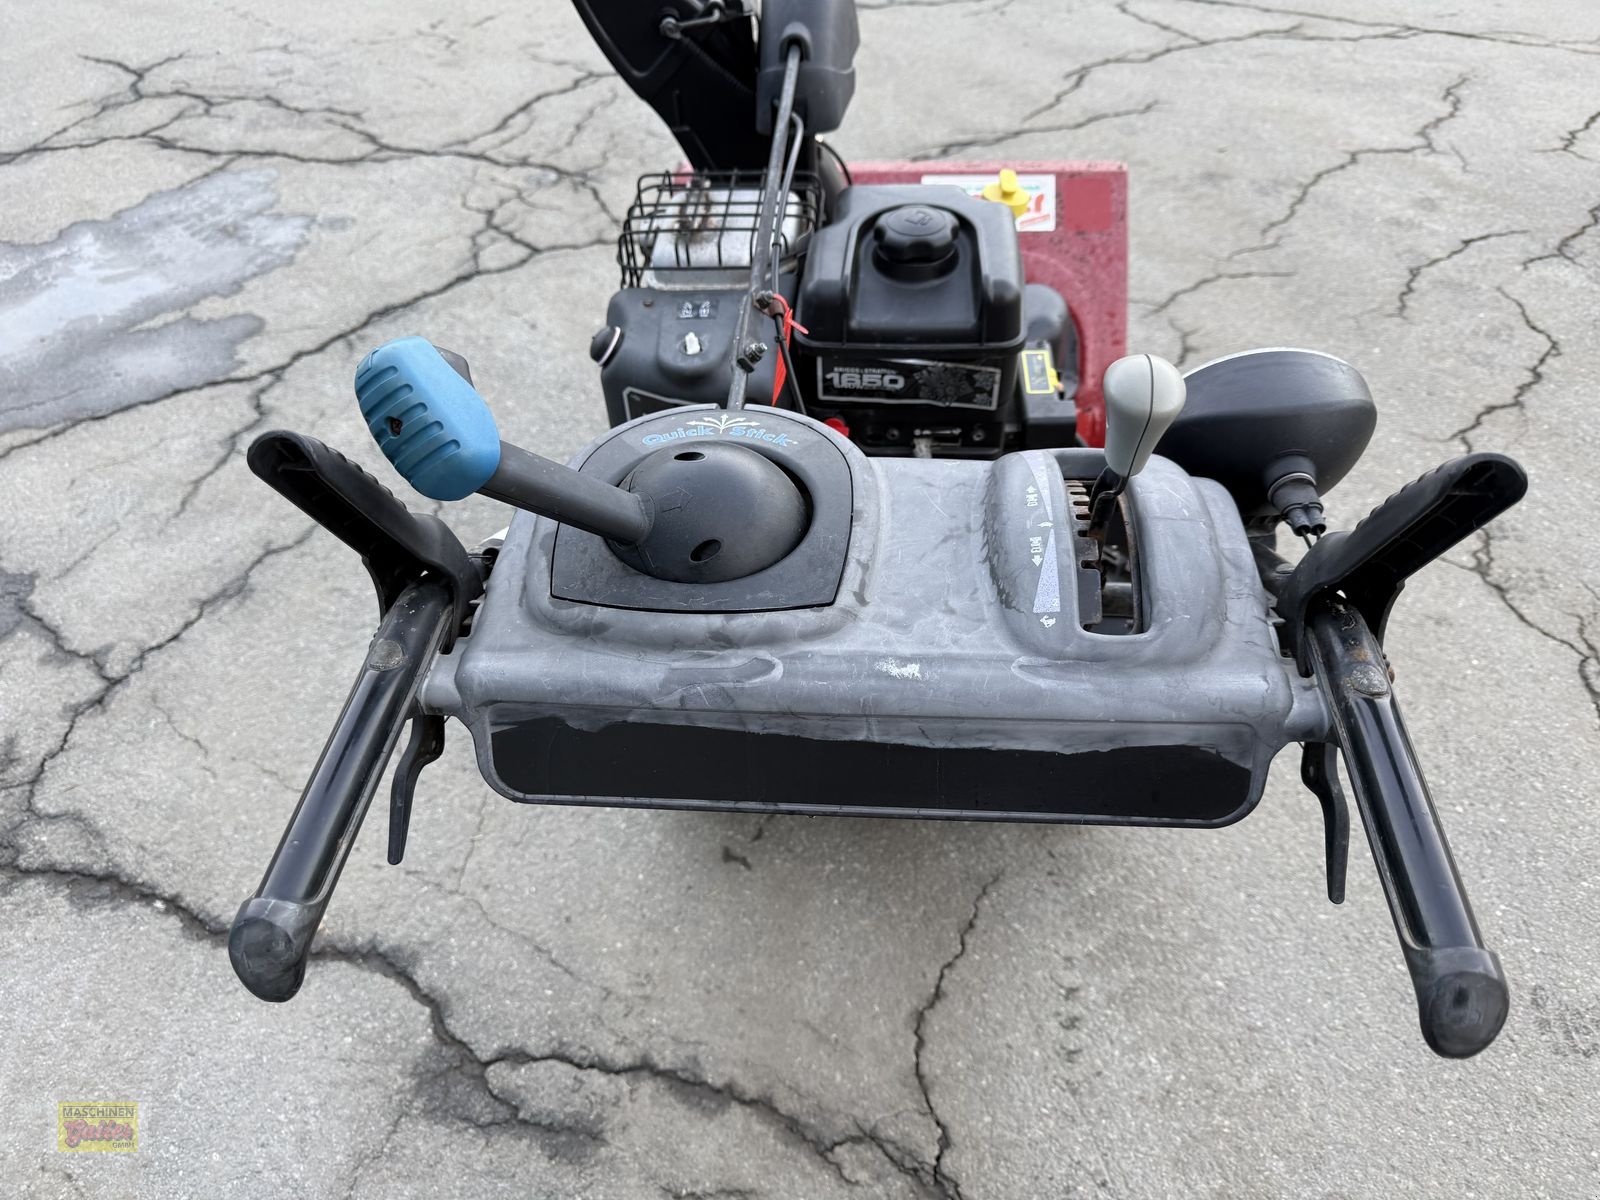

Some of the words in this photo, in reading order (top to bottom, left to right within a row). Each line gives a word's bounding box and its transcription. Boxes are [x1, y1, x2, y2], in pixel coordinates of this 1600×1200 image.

[825, 372, 905, 390] 1650
[642, 426, 715, 447] Quick
[729, 426, 792, 447] Stick
